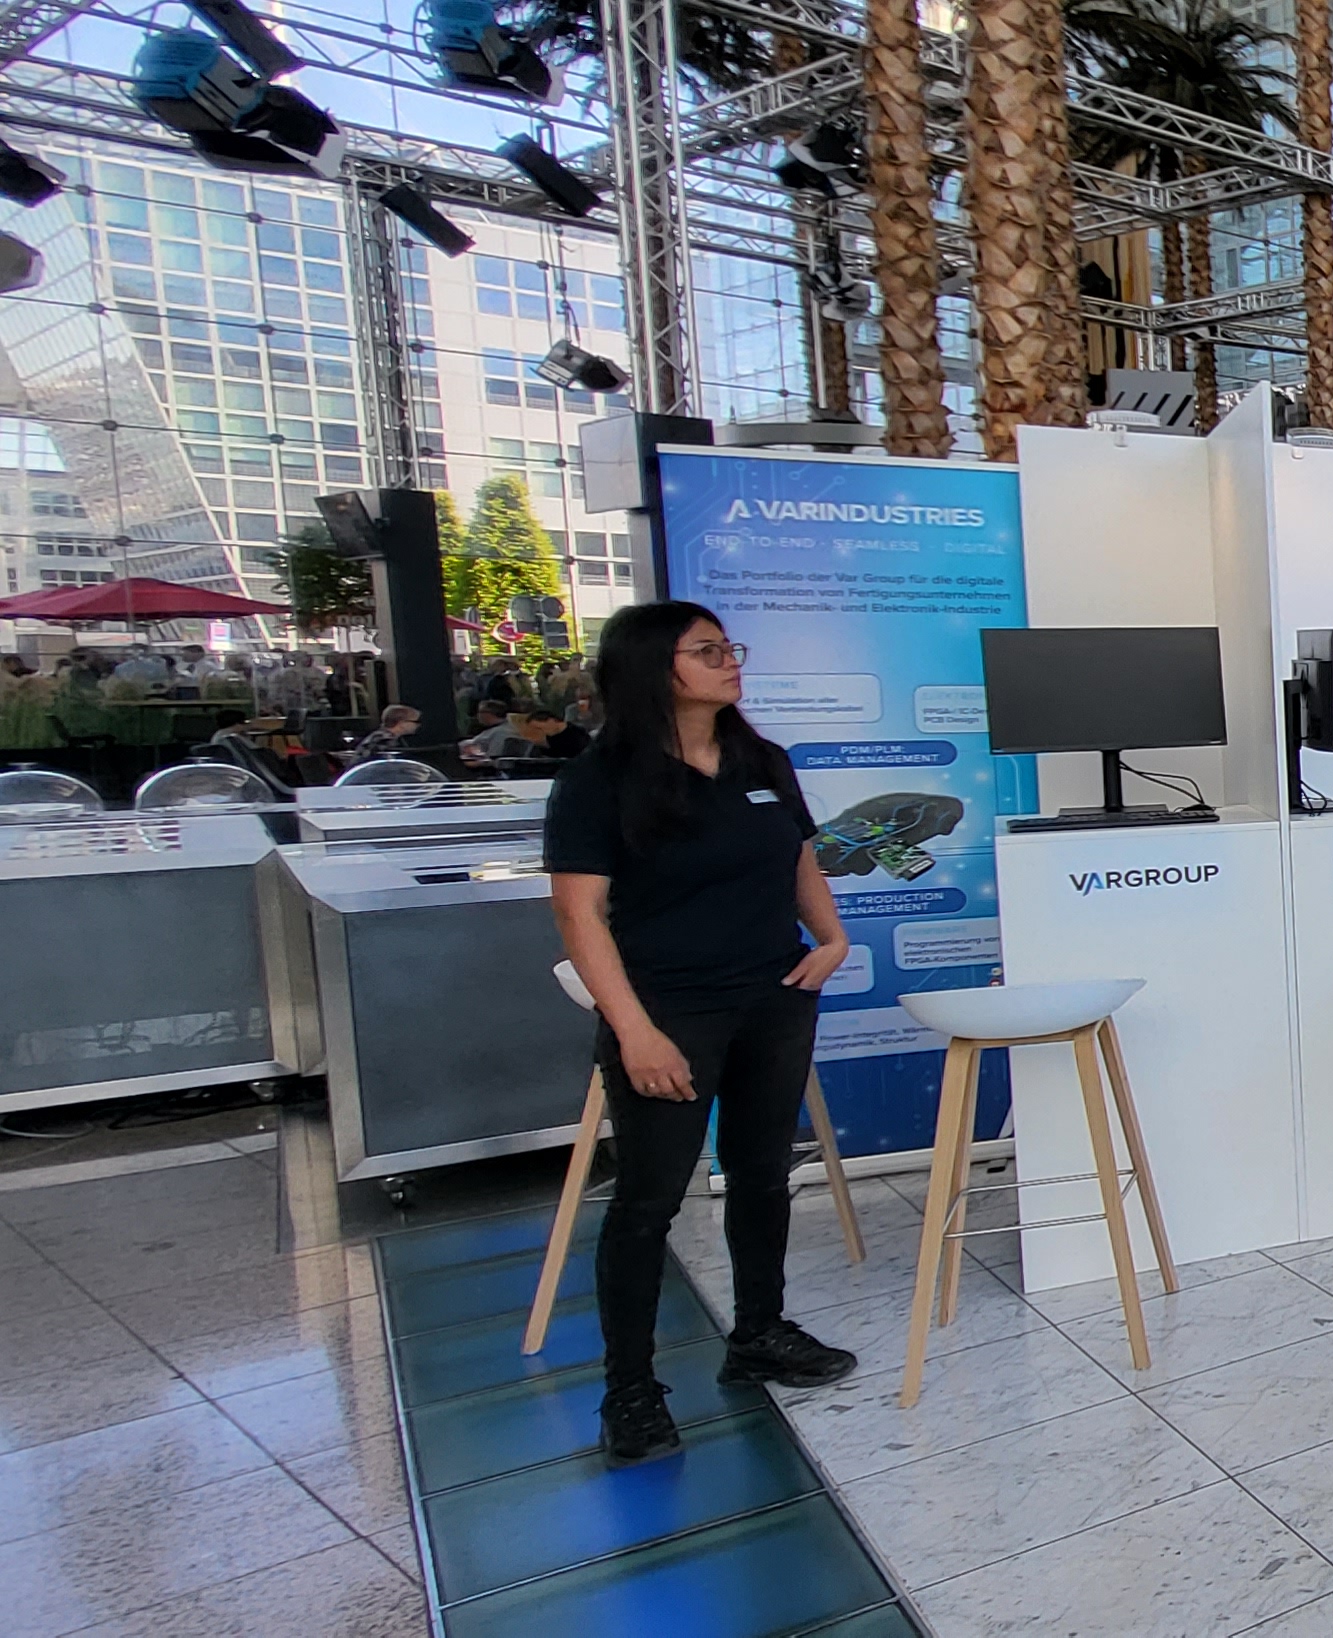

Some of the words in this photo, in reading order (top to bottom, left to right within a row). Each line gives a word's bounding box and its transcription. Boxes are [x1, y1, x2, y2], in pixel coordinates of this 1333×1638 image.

[755, 499, 985, 527] VARINDUSTRIES
[704, 534, 816, 548] END-TO-END
[832, 538, 920, 552] SEAMLESS
[944, 542, 1006, 555] DIGITAL
[708, 569, 737, 580] Das
[742, 569, 804, 581] Portfolio
[808, 570, 831, 582] der
[836, 571, 857, 583] Var
[863, 573, 905, 585] Group
[909, 573, 928, 584] für
[932, 574, 952, 585] die
[956, 575, 1004, 587] digitale
[703, 584, 814, 596] Transformation
[818, 587, 844, 597] von
[848, 587, 1011, 601] Fertigungsunternehmen
[733, 602, 759, 611] der
[763, 602, 836, 612] Mechanik-
[841, 603, 867, 613] und
[871, 603, 1002, 614] Elektronik-Industrie
[806, 756, 842, 766] DATA
[846, 753, 940, 765] MANAGEMENT
[1068, 864, 1220, 897] VARGROUP
[857, 892, 945, 905] PRODUCTION
[838, 902, 931, 915] MANAGEMENT
